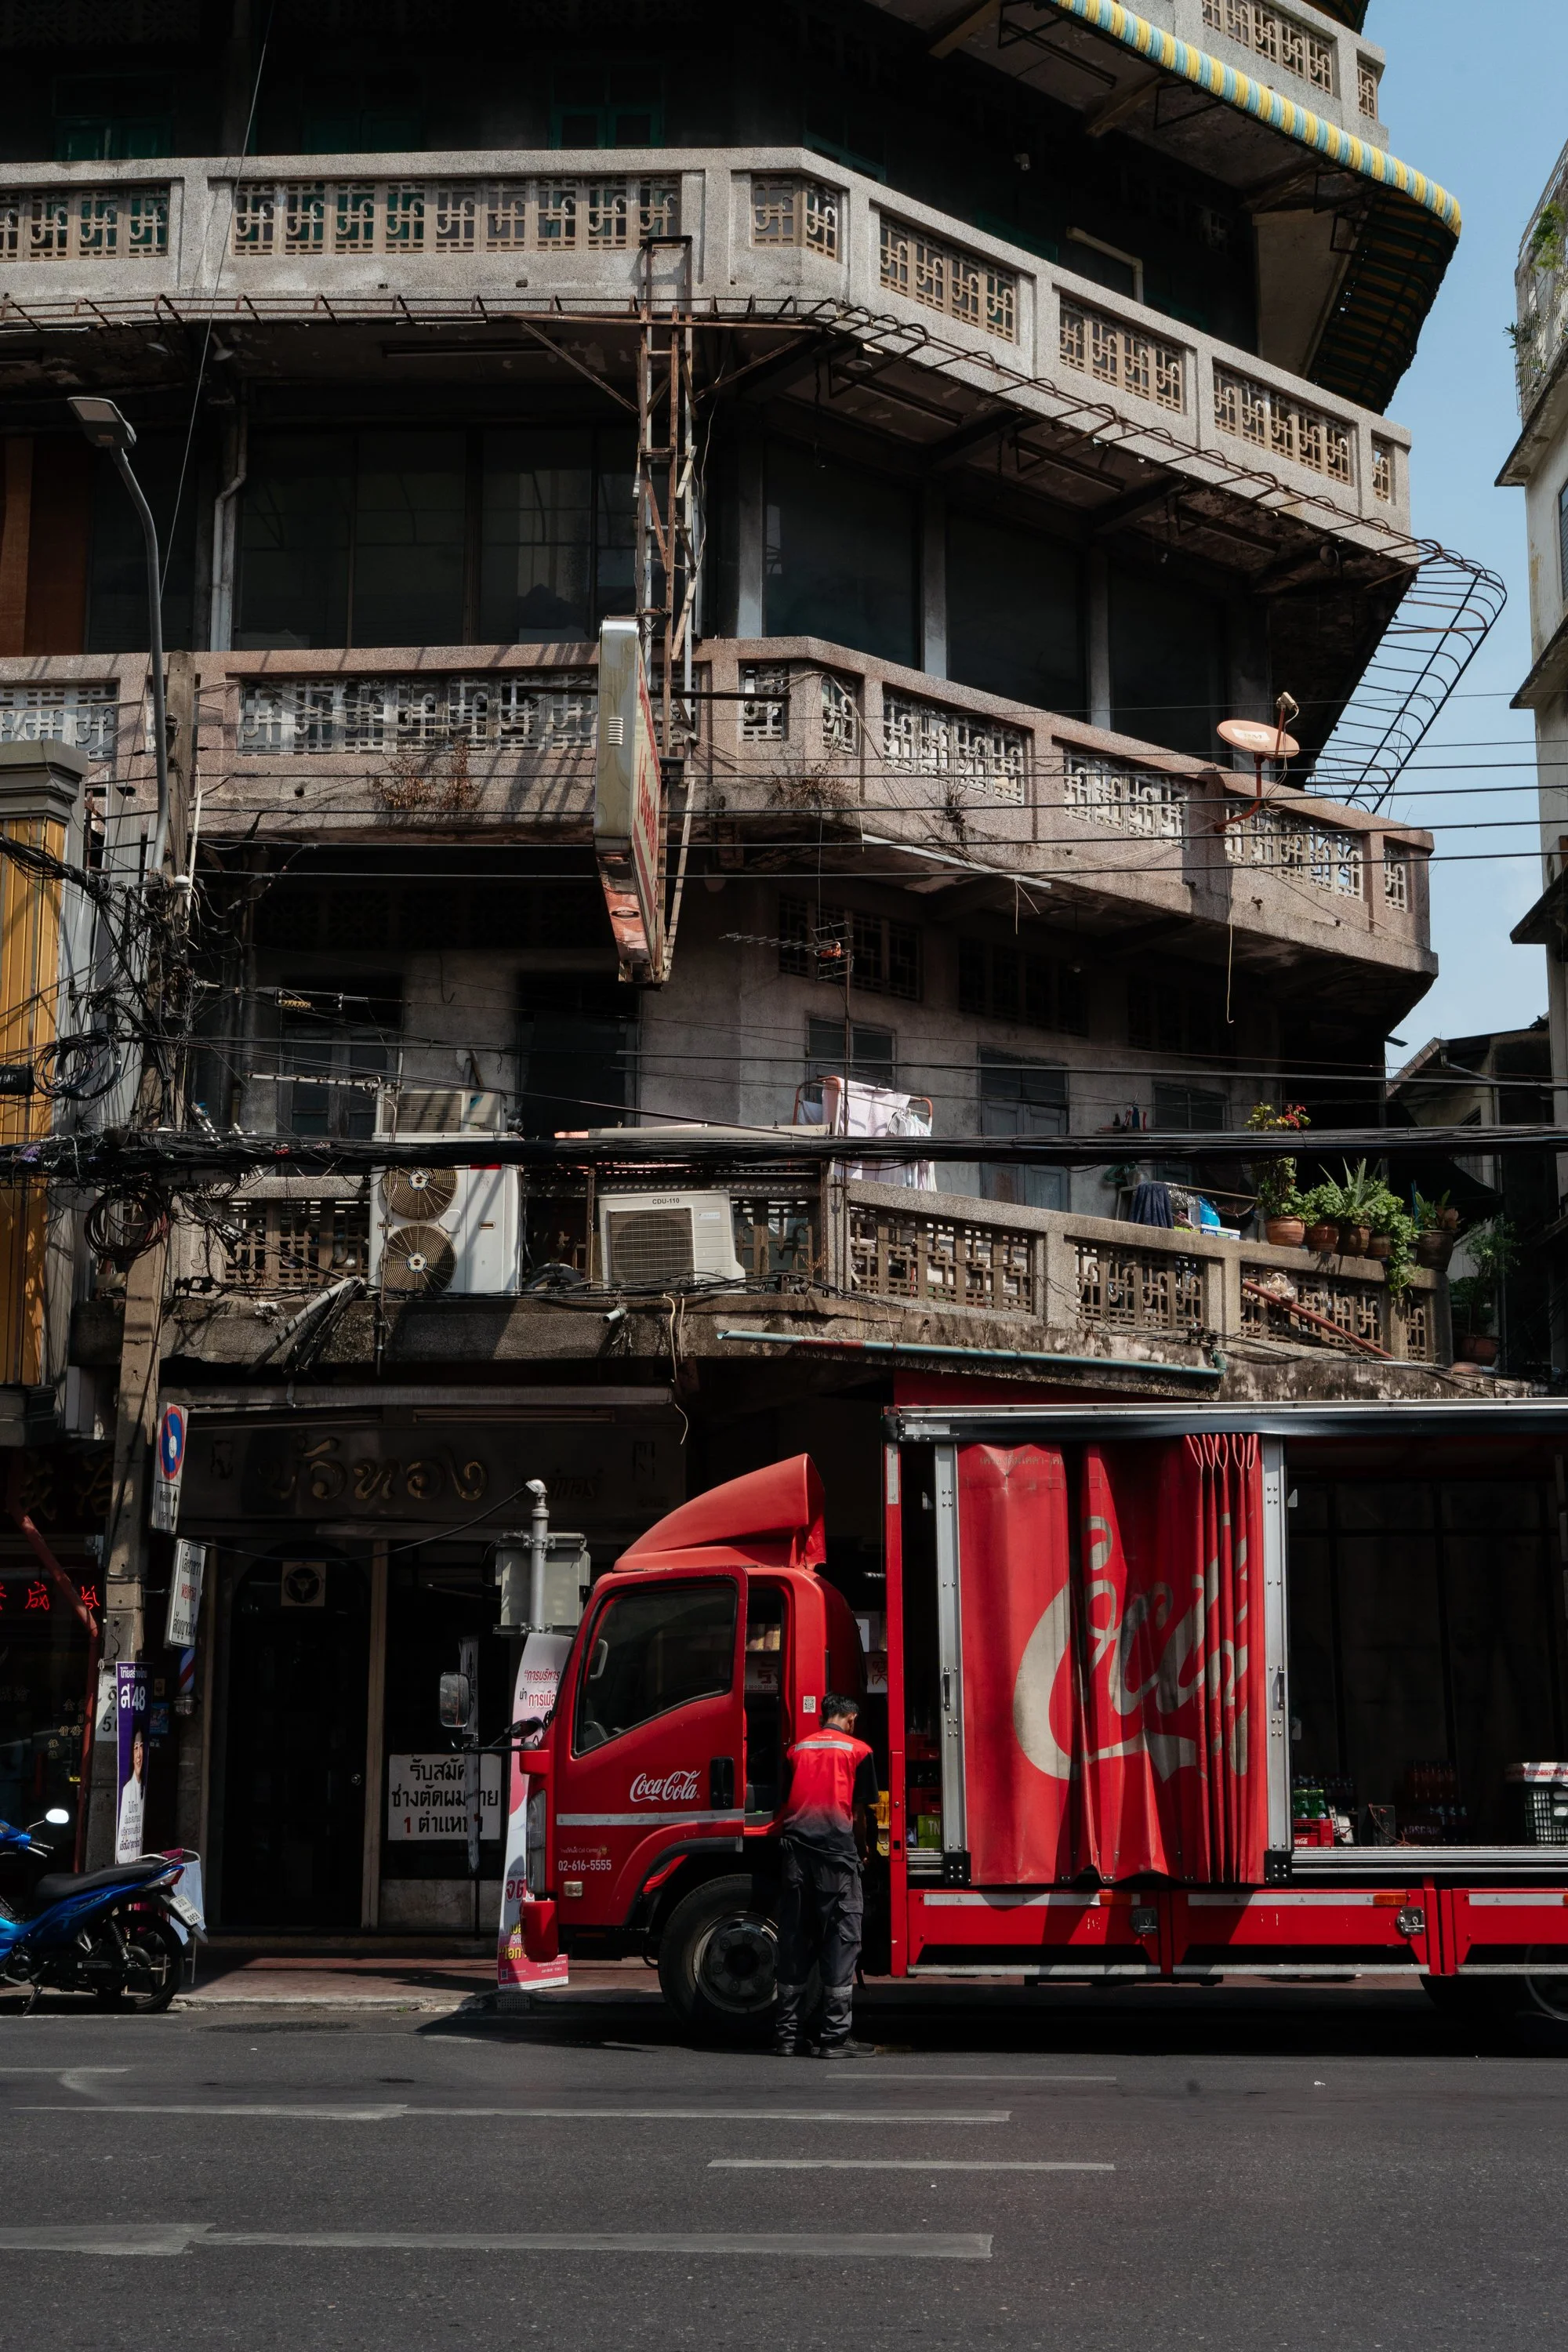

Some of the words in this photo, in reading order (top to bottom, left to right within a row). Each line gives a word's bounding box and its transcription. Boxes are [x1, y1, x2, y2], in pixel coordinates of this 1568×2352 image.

[528, 1690, 557, 1707] การเมือ
[410, 1759, 465, 1780] รับสมัค
[392, 1784, 499, 1807] ช่างตัดผมาย
[630, 1770, 702, 1802] Coca-Cola
[404, 1817, 412, 1834] 1
[558, 1859, 612, 1871] 02-616-5555
